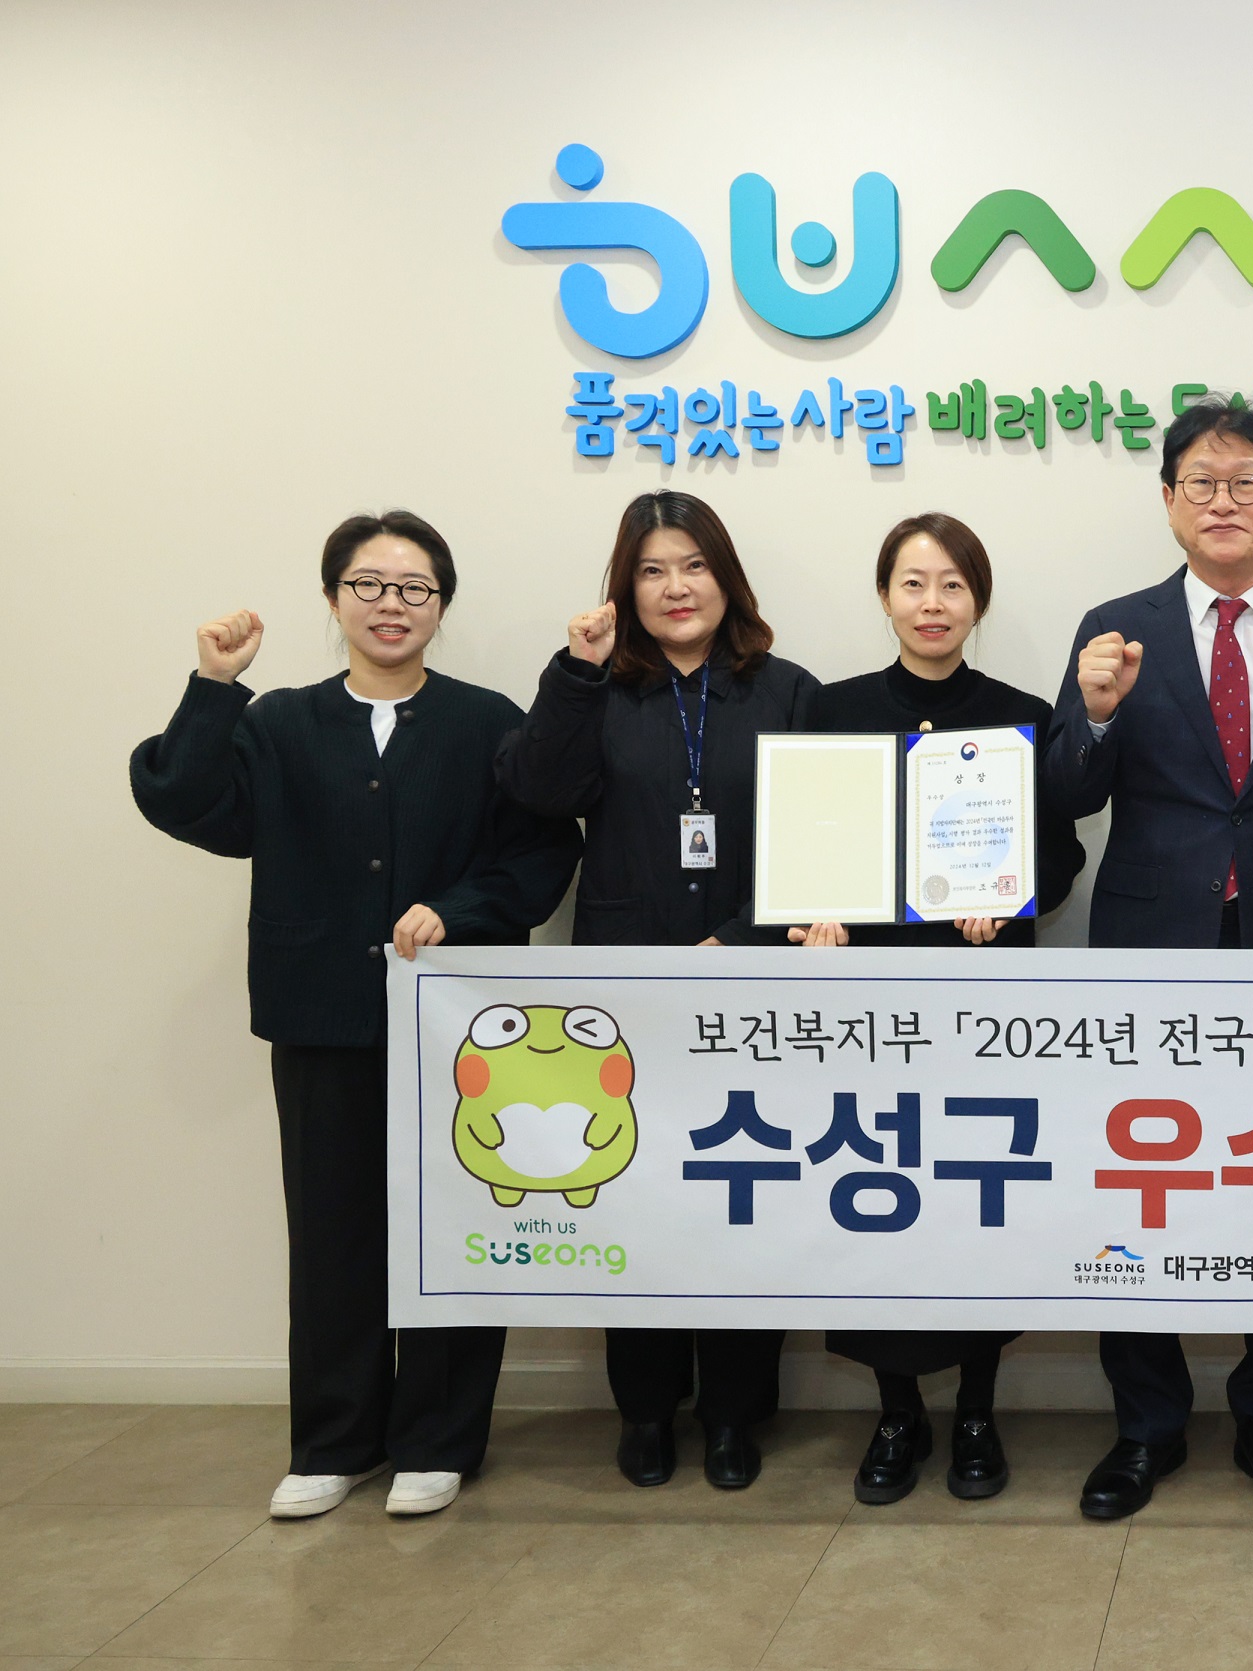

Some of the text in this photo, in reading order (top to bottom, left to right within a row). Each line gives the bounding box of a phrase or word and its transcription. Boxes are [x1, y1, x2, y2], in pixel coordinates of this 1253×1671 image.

[688, 1011, 933, 1065] 보건복지부
[956, 1011, 1139, 1066] 「2024년
[683, 1090, 1052, 1233] 수성구
[513, 1218, 577, 1235] with us
[465, 1232, 627, 1276] Suseong
[1074, 1262, 1145, 1274] SUSEONG
[1074, 1275, 1146, 1286] 대구광역시 수성구
